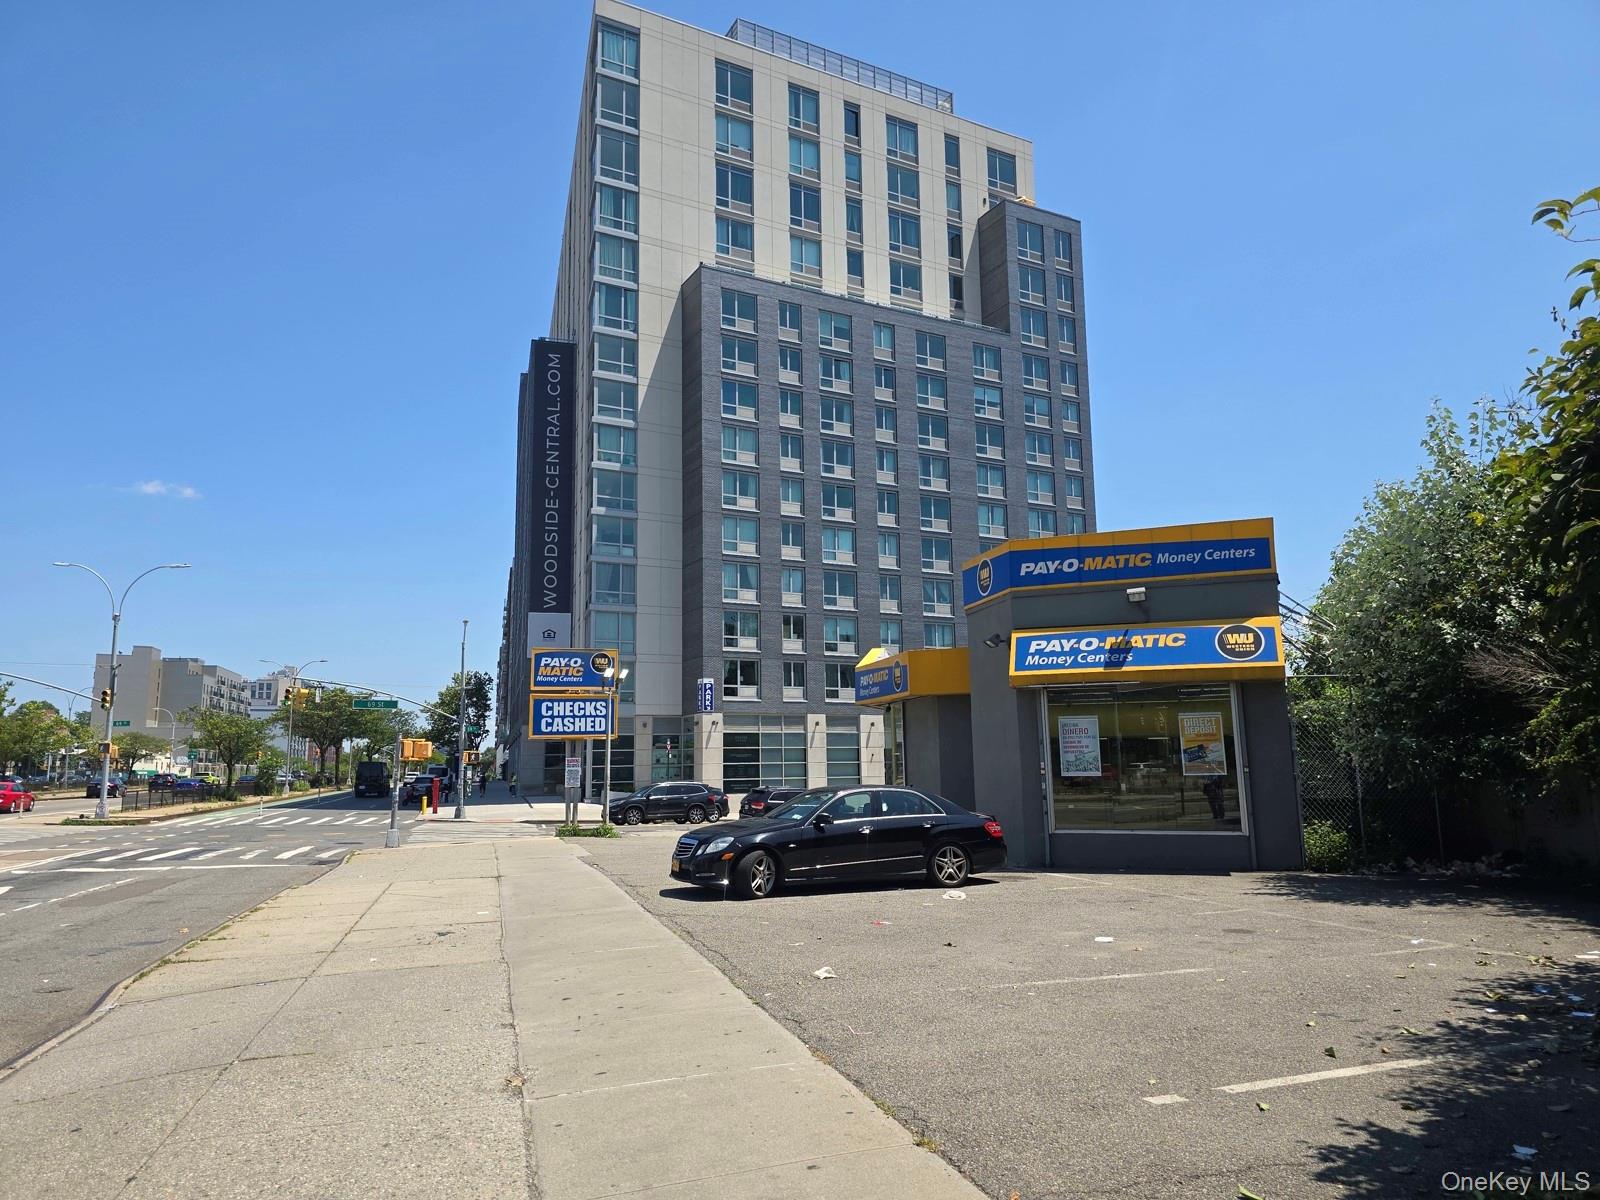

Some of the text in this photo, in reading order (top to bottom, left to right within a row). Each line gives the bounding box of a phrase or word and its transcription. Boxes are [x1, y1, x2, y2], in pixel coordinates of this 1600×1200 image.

[543, 353, 561, 608] WOODSIDE-CENTRAL.COM
[1019, 543, 1256, 576] PAY-O-MATIC Money Centers
[1029, 633, 1186, 653] PAY-O-MATIC
[540, 657, 585, 667] PAY-O-
[1025, 652, 1132, 667] Money Centers
[538, 666, 584, 676] MATIC
[536, 675, 559, 683] Money
[541, 702, 607, 716] CHECKS
[541, 717, 606, 732] CASHED
[1183, 717, 1217, 727] DIRECT
[1062, 727, 1089, 735] DINERO
[1184, 725, 1217, 735] DEPOSIT
